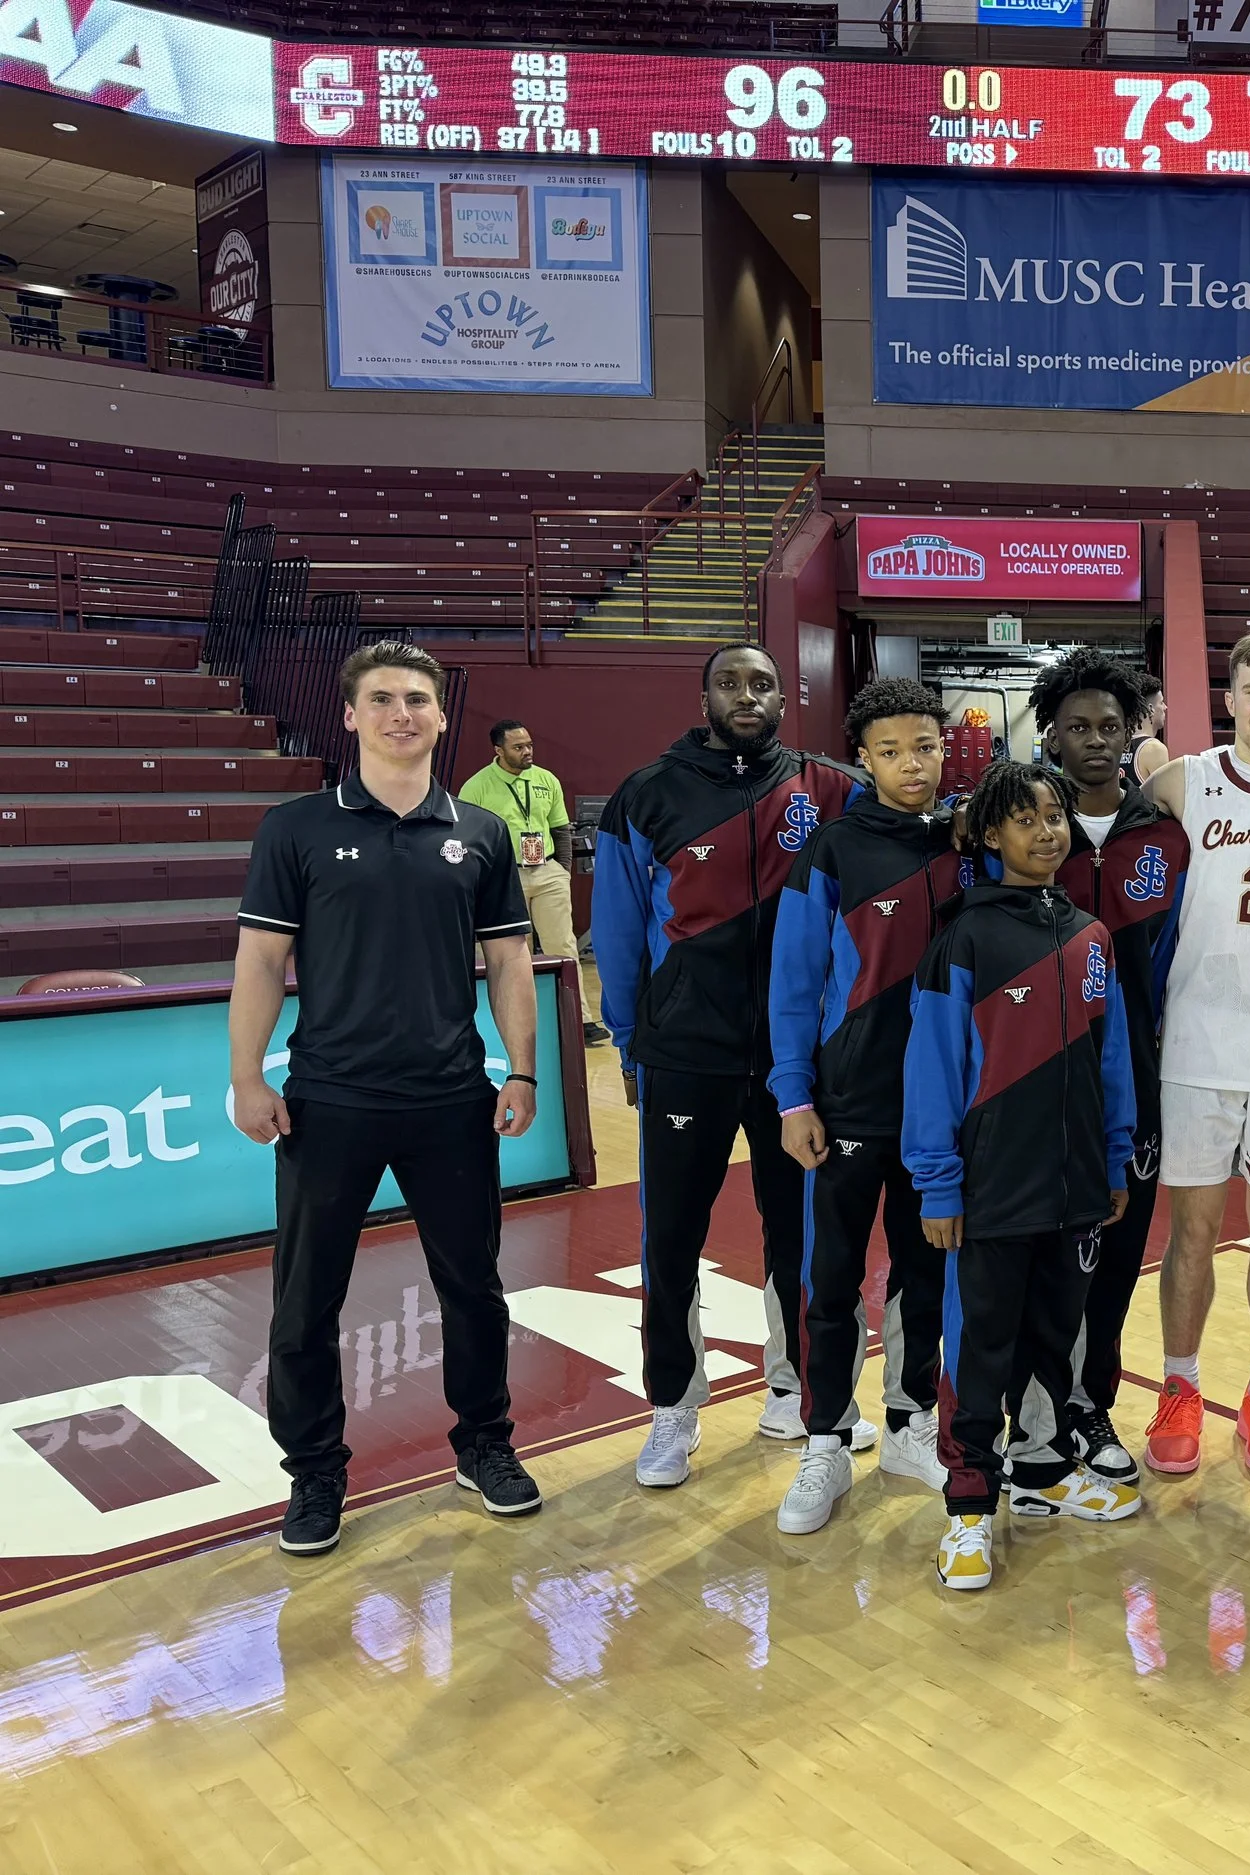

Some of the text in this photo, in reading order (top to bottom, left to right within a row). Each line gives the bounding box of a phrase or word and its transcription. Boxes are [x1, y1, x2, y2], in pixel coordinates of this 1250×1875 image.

[378, 50, 424, 73] FG%
[379, 74, 439, 99] 3PT%
[724, 64, 827, 130] 96
[943, 69, 1001, 112] 0.0
[380, 99, 424, 122] FT%
[1115, 78, 1213, 143] 73
[380, 124, 419, 146] REB
[426, 125, 481, 150] (OFF)
[929, 115, 1044, 139] 2nd HALF
[653, 131, 756, 158] FOULS 10
[787, 136, 853, 162] TOL 2
[947, 142, 995, 165] POSS
[1094, 145, 1161, 171] TOL 2
[390, 171, 420, 179] STREET
[465, 173, 485, 181] KING
[487, 174, 517, 182] STREET
[547, 176, 606, 185] 23 ANN STREET
[199, 163, 259, 216] BUD LIGHT
[456, 208, 513, 222] UPTOWN
[463, 231, 509, 245] SOCIAL
[355, 267, 432, 277] @SHAREHOUSECHS
[444, 269, 530, 280] @UPTOWNSOCIALCHS
[541, 272, 620, 282] @EATDRINKBODEGA
[973, 257, 1144, 306] MUSC
[210, 267, 254, 313] OUR CITY
[421, 289, 555, 350] UPTOWN
[457, 328, 518, 339] HOSPITALITY
[471, 340, 506, 350] GROUP
[889, 341, 931, 364] The
[937, 343, 1011, 368] official
[1016, 350, 1081, 374] sports
[1087, 349, 1183, 373] medicine
[912, 536, 940, 546] PIZZA
[1000, 542, 1131, 560] LOCALLY OWNED.
[872, 549, 915, 576] PAPA
[1007, 562, 1124, 576] LOCALLY OPERATED.
[994, 621, 1018, 642] EXIT
